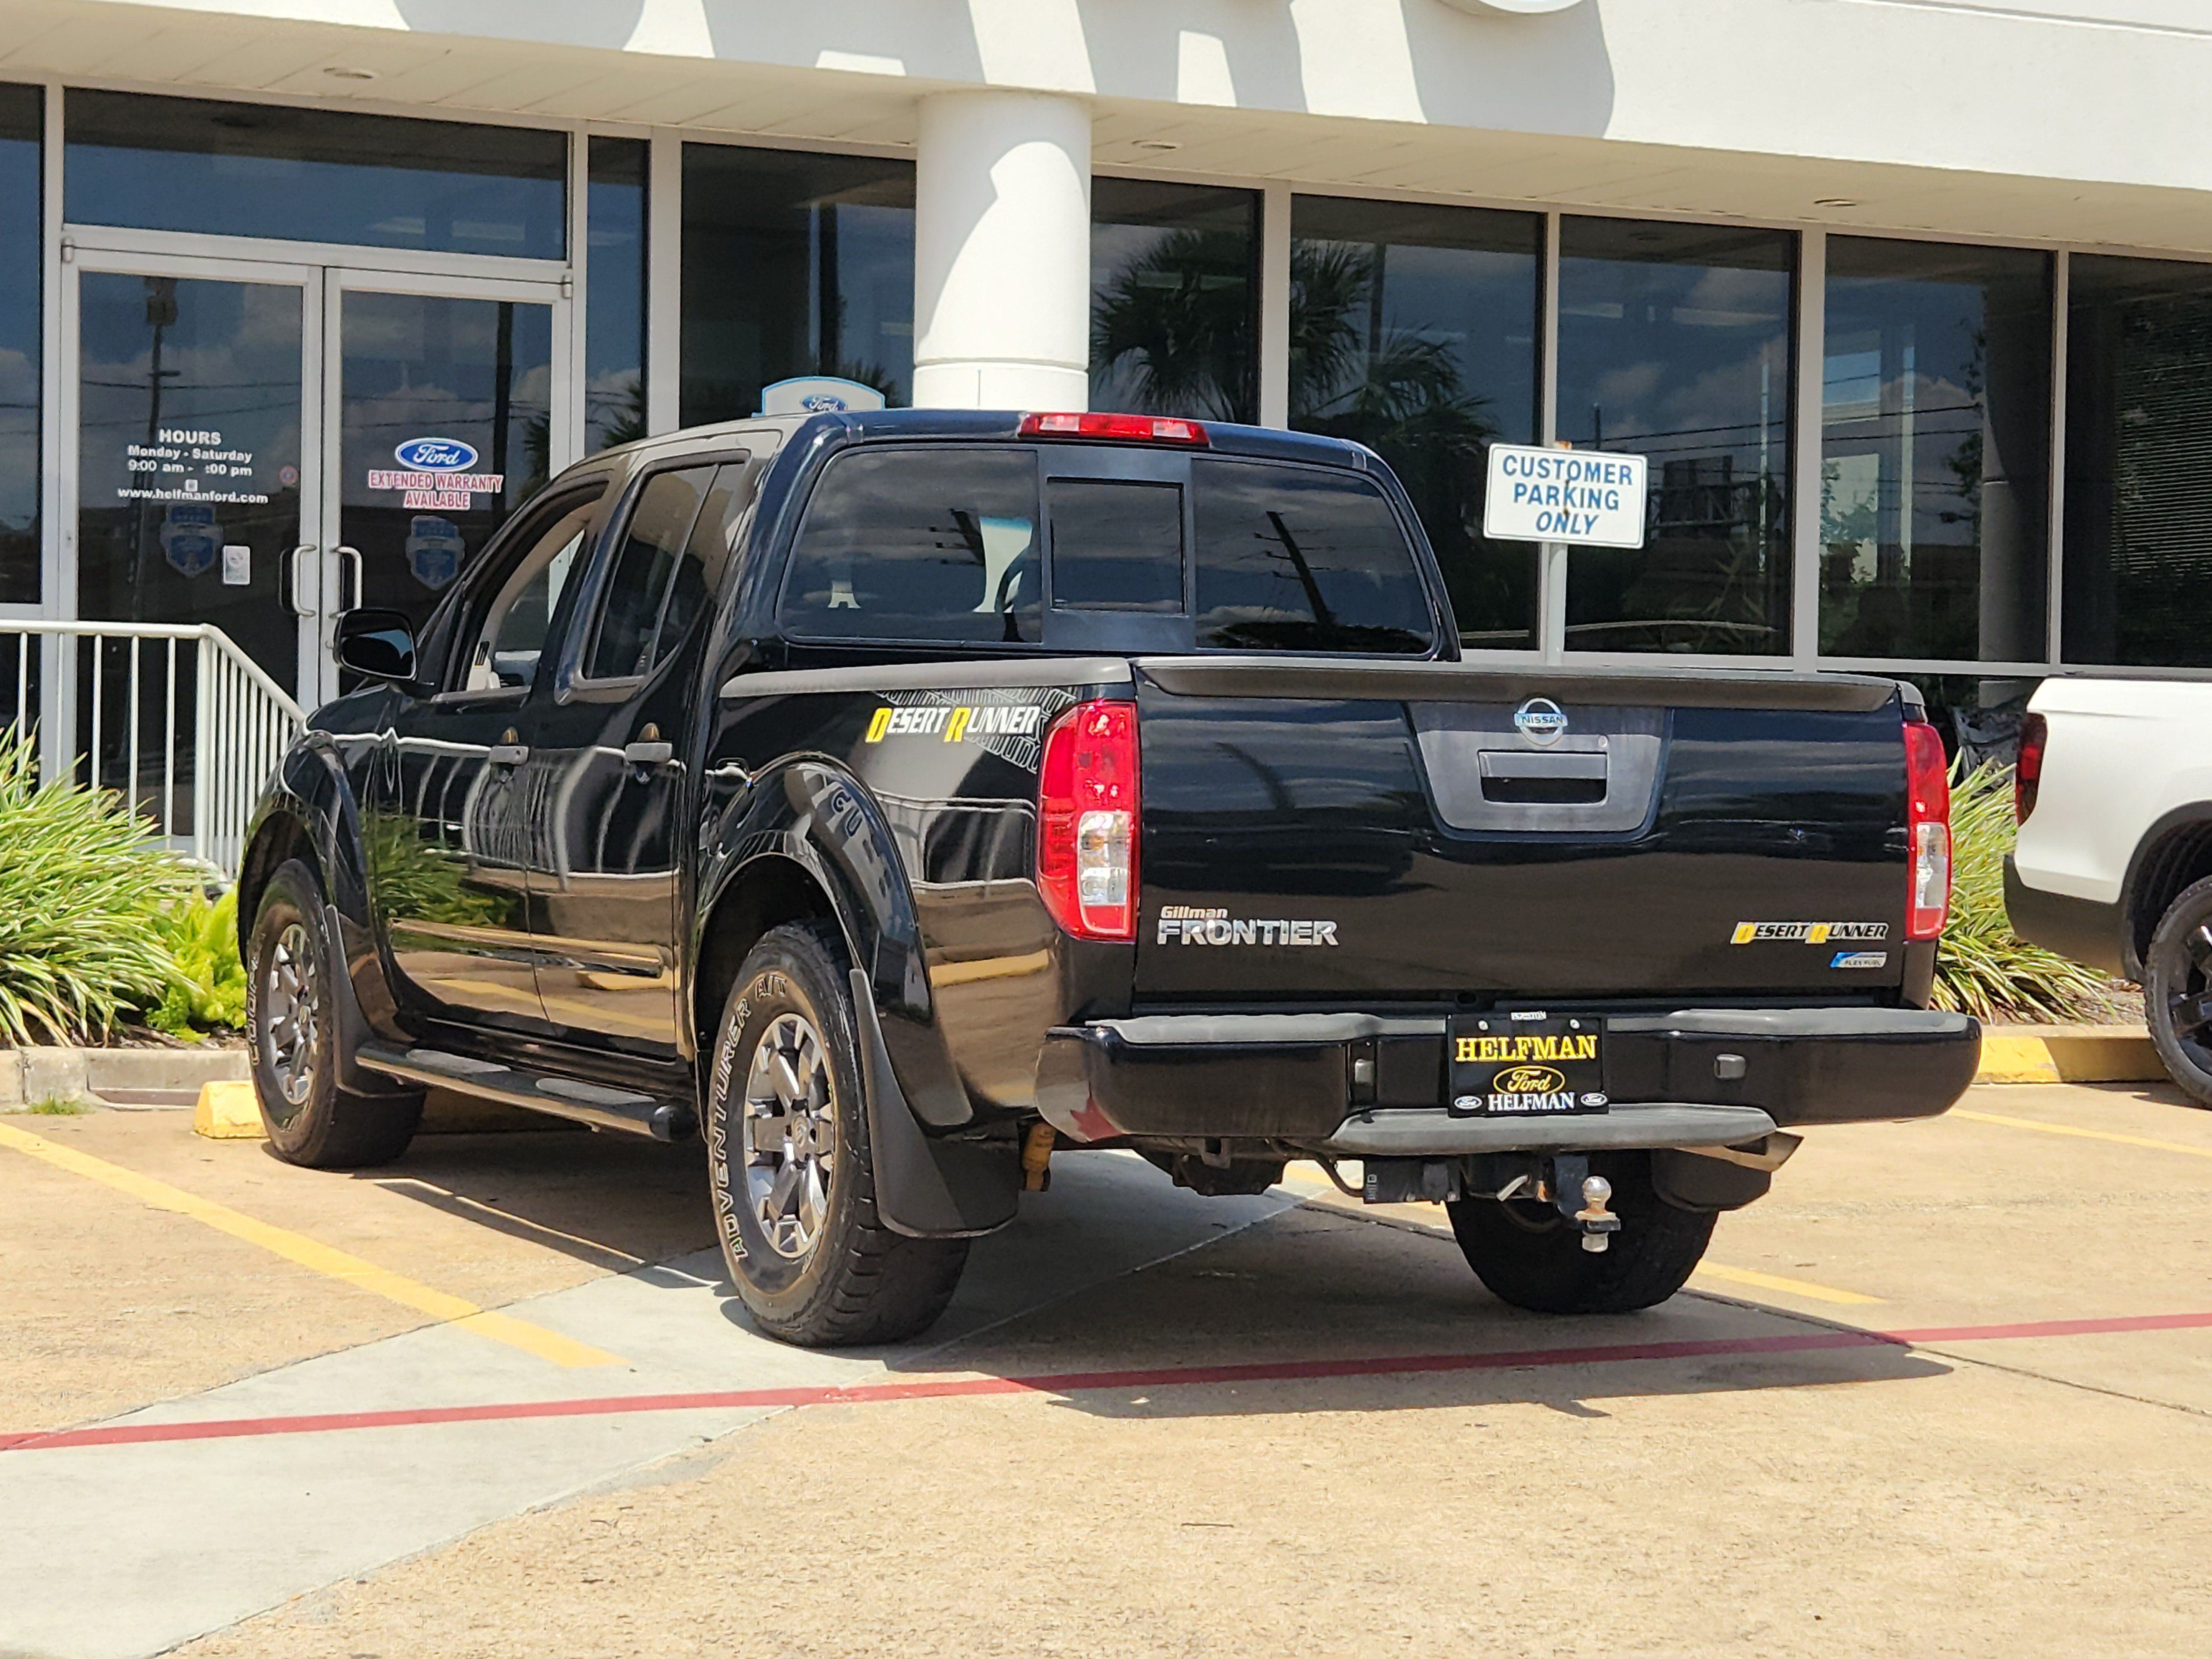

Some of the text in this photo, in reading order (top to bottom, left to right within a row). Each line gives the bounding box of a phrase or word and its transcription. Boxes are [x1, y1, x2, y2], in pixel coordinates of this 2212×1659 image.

[158, 429, 222, 445] HOURS
[127, 444, 181, 460] Monday
[192, 447, 253, 464] Saturday
[413, 444, 461, 465] Ford
[128, 459, 157, 472] 9:00
[162, 463, 184, 473] am
[230, 465, 253, 477] pm
[1502, 455, 1633, 485] CUSTOMER
[370, 471, 503, 492] EXTENDED WARRANTY
[118, 488, 269, 504] www.helfmanford.com
[405, 492, 470, 508] AVAILABLE
[1513, 482, 1619, 511] PARKING
[1536, 511, 1599, 535] ONLY
[865, 706, 1041, 743] DESERT RUNNER
[1521, 715, 1564, 724] NISSAN
[1161, 905, 1229, 919] Gillman
[1157, 918, 1339, 946] FRONTIER
[1733, 923, 1887, 943] DESERT RUNNER
[755, 974, 787, 1000] A/T
[1455, 1035, 1598, 1062] HELFMAN
[1507, 1070, 1552, 1092] Ford
[1487, 1092, 1576, 1111] HELFMAN
[713, 997, 752, 1263] ADVENTURER
